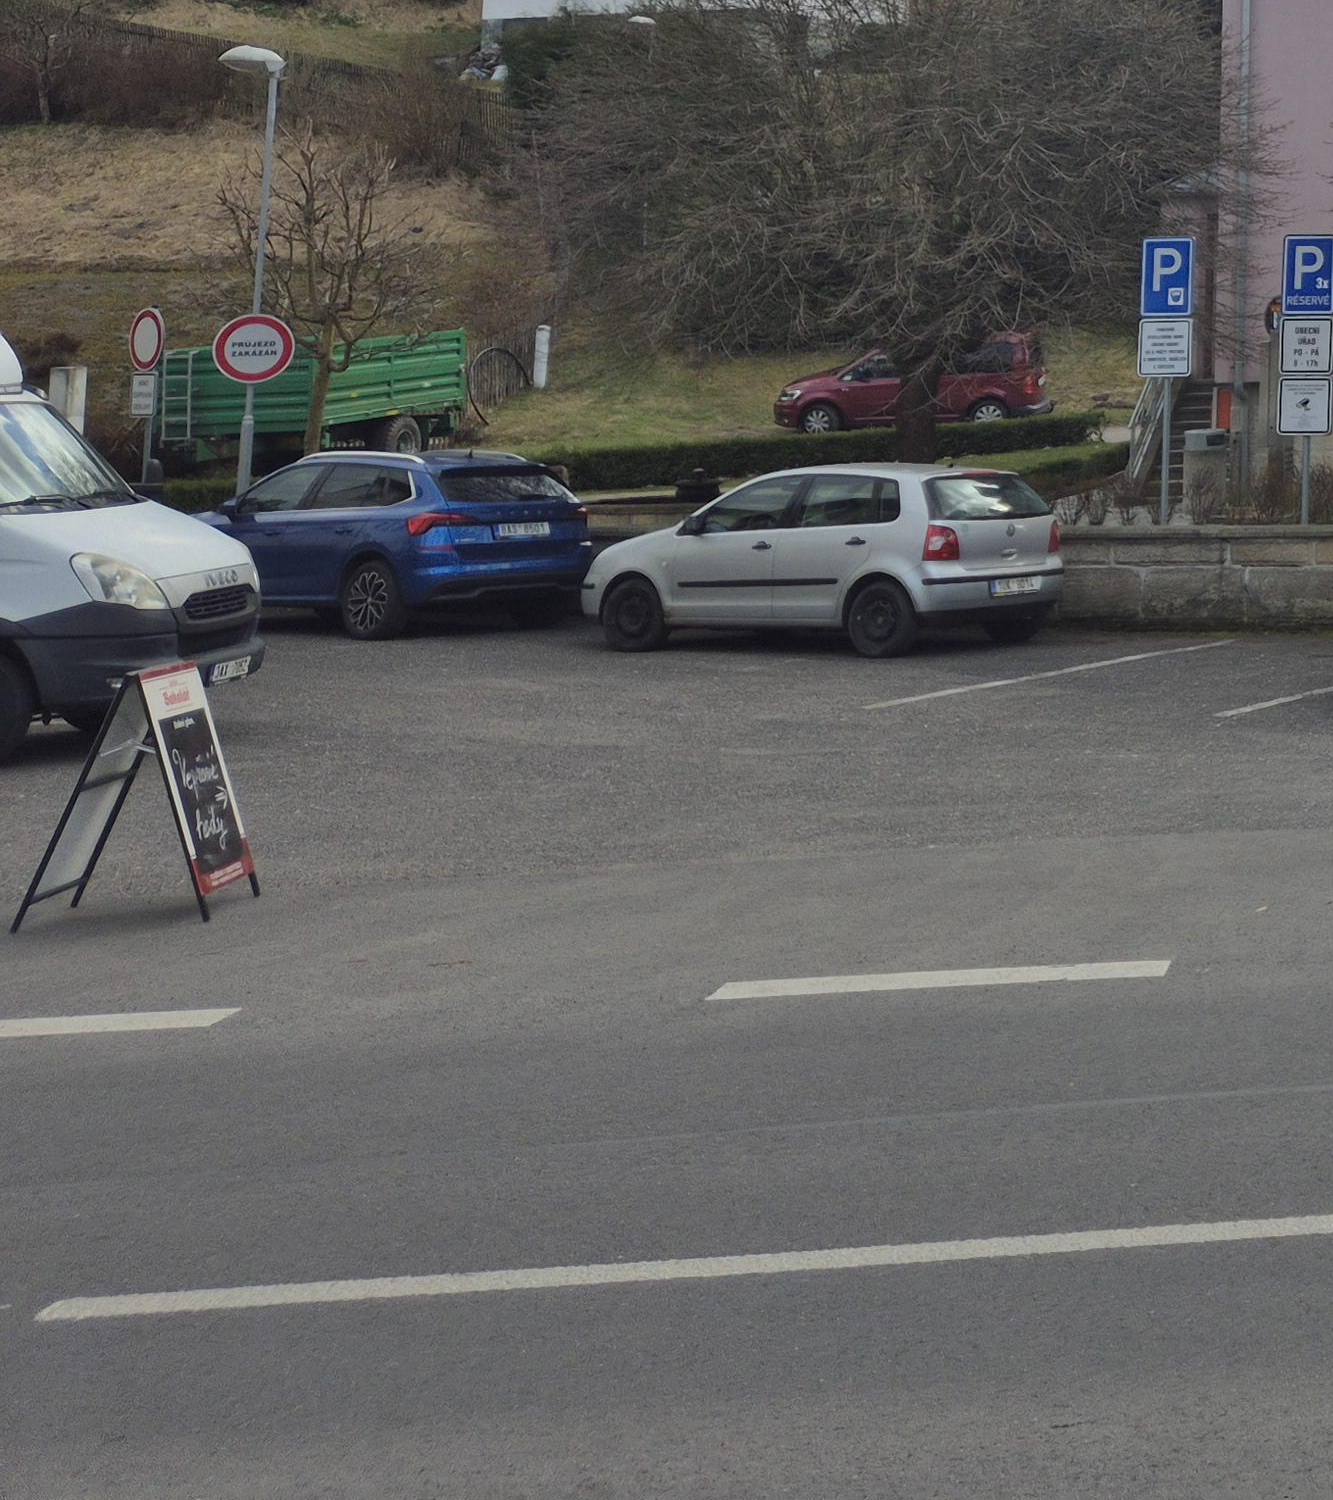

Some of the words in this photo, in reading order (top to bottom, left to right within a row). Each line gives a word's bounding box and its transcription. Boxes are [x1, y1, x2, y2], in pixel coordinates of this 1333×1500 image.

[1152, 247, 1182, 292] P
[1294, 246, 1324, 290] P
[1286, 294, 1330, 306] RÉSERVÉ
[205, 569, 239, 588] IVECO
